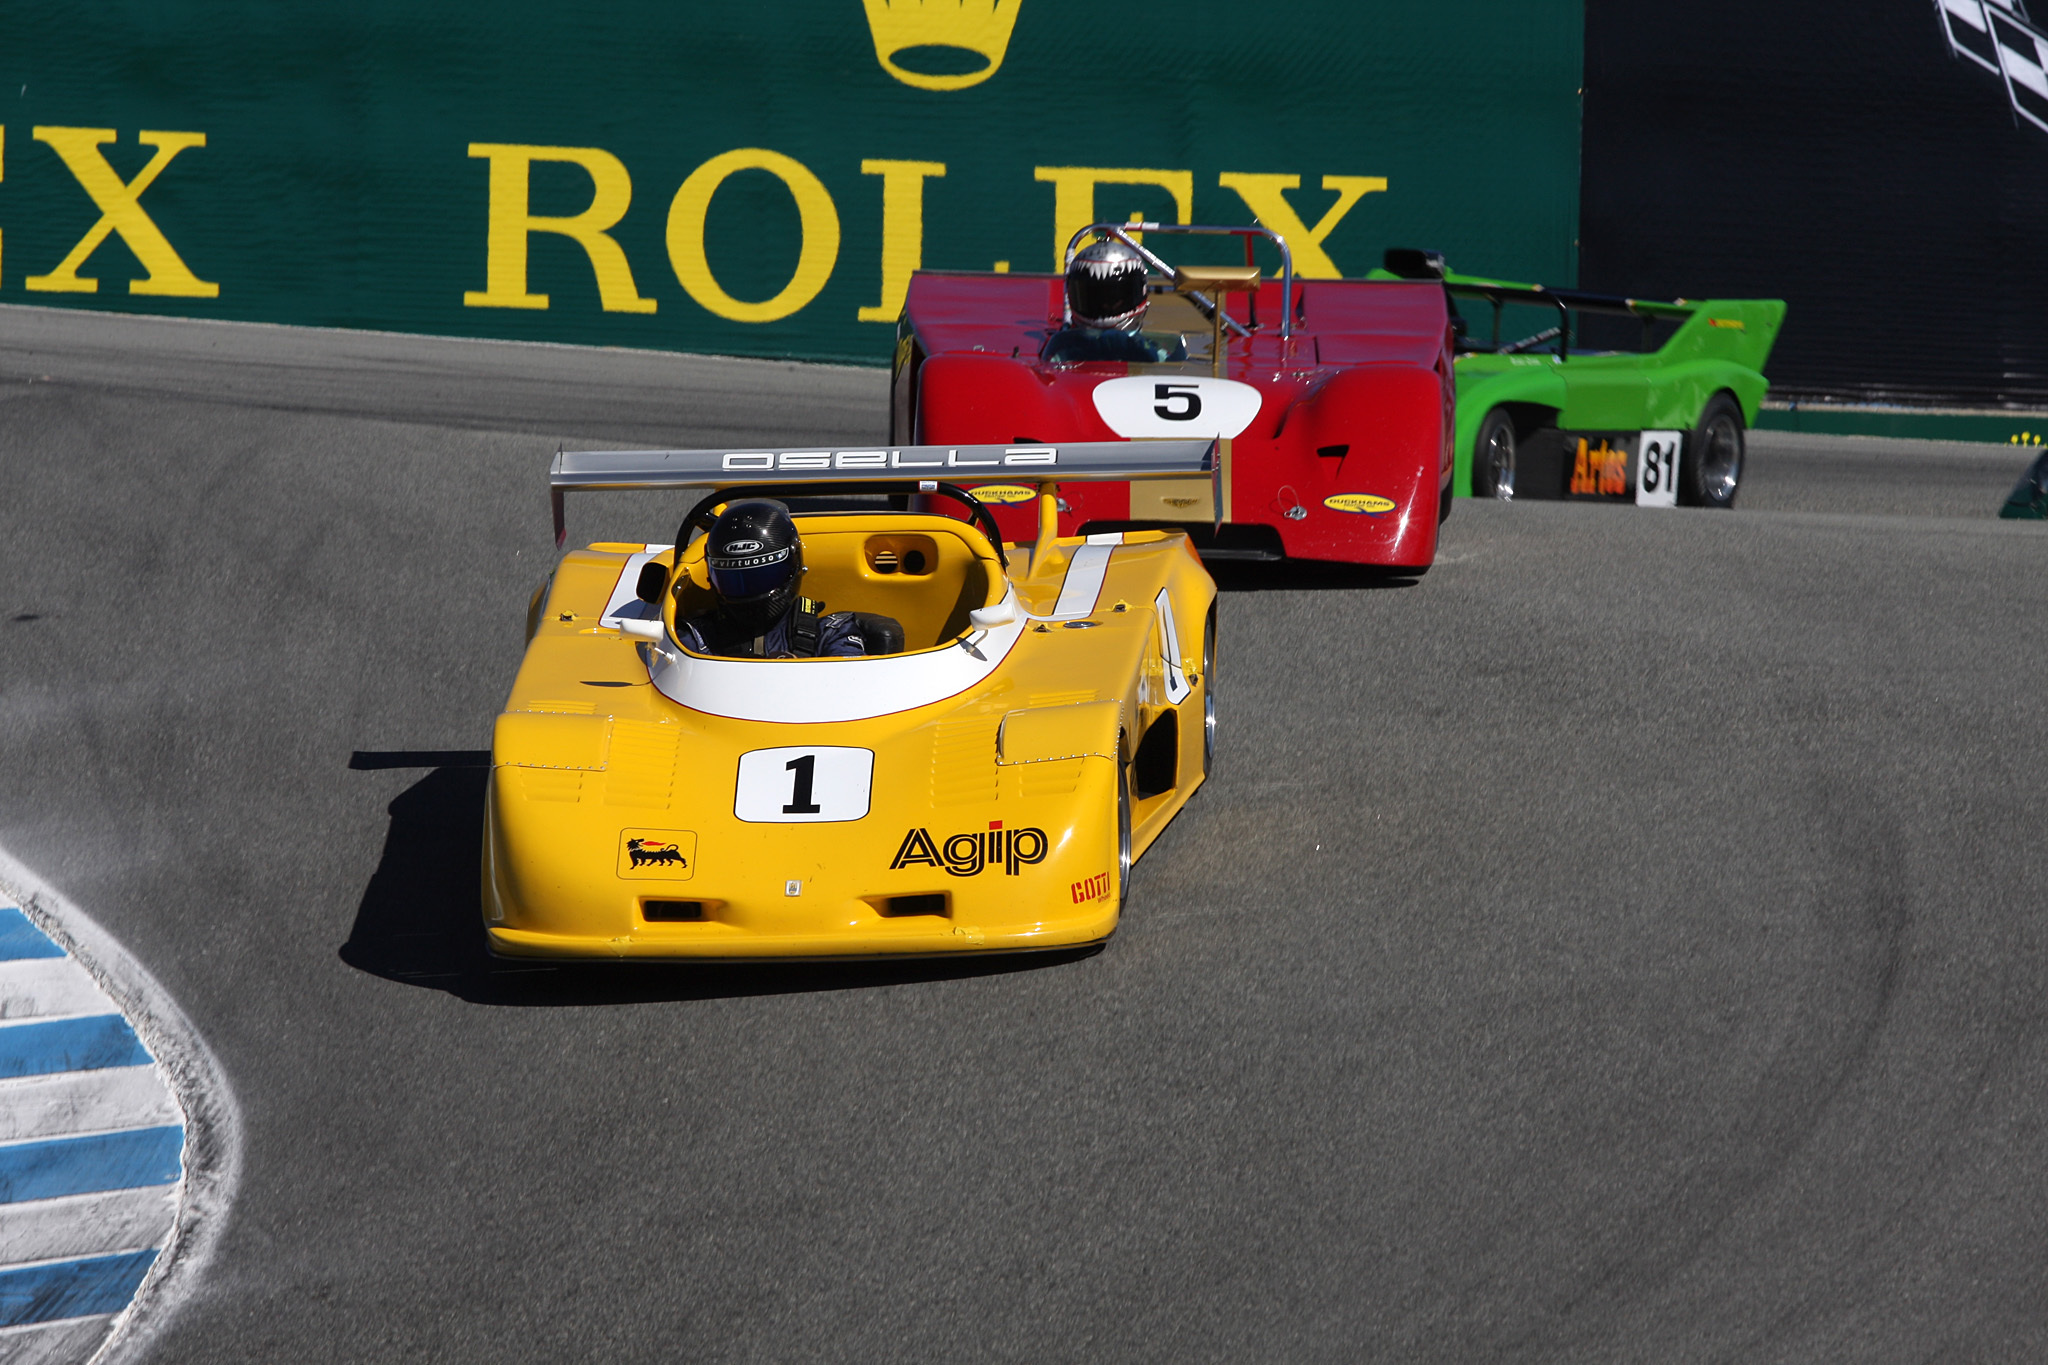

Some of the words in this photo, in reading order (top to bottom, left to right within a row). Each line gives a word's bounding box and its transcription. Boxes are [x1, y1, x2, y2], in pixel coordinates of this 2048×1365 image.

[1153, 384, 1202, 421] 5
[1643, 440, 1675, 493] 81
[720, 555, 774, 567] virtuoso
[728, 542, 756, 552] HJC
[782, 754, 821, 814] 1
[888, 820, 1049, 878] Agip
[1070, 871, 1111, 905] GOTTI
